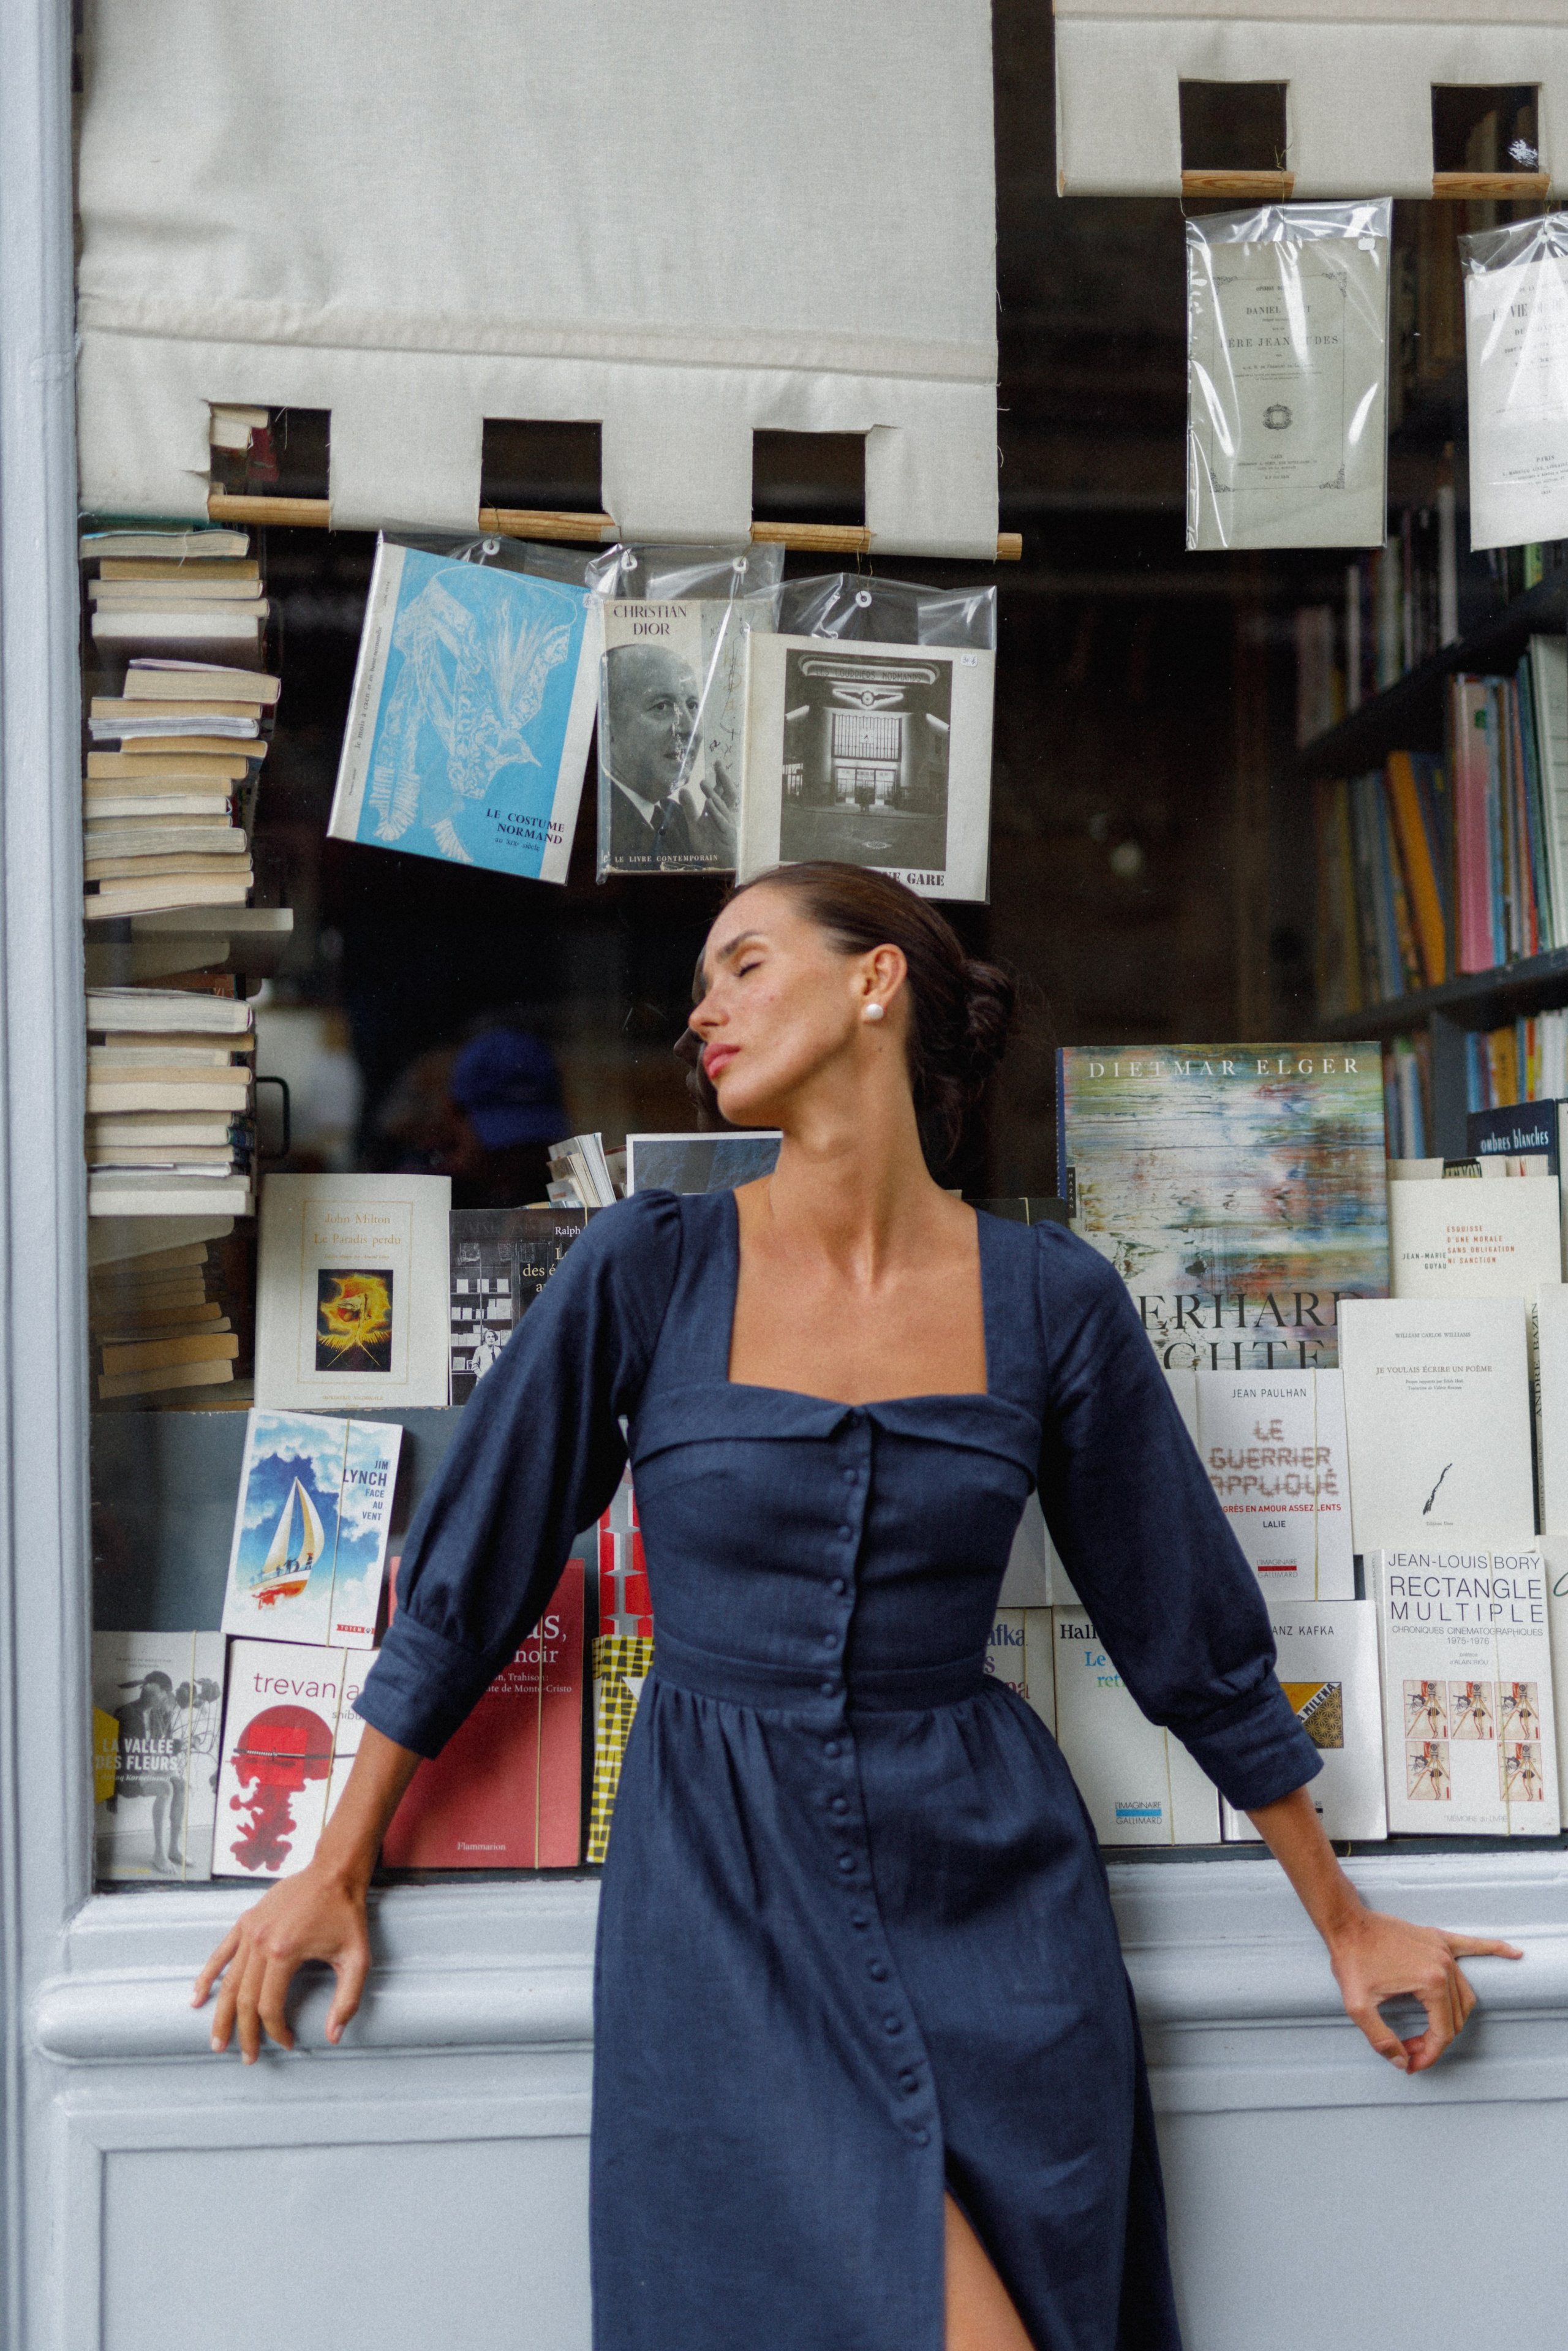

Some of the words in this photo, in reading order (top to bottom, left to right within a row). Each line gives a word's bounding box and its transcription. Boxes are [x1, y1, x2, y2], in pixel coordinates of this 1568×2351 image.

[1246, 306, 1281, 315] DANIEL
[1257, 338, 1291, 347] JEAN
[1306, 336, 1339, 345] UDES
[614, 605, 687, 618] CHRISTIAN
[633, 622, 670, 636] DIOR
[882, 671, 922, 682] NORMANDS
[486, 808, 501, 819] LE
[507, 812, 565, 832] COSTUME
[497, 823, 563, 844] NORMAND
[522, 842, 541, 851] siècle
[656, 854, 718, 862] CONTEMPORAIN
[907, 872, 944, 886] GARE
[1088, 1060, 1237, 1079] DIETMAR
[1256, 1058, 1359, 1076] ELGER
[325, 1213, 350, 1224] John
[355, 1213, 391, 1225] Milton
[555, 1226, 581, 1237] Ralph
[313, 1233, 328, 1245] Le
[332, 1233, 368, 1245] Paradis
[372, 1234, 401, 1248] perdu
[522, 1263, 545, 1277] des
[1139, 1290, 1363, 1330] ERHAR
[1376, 1367, 1385, 1375] JE
[1232, 1389, 1256, 1398] JEAN
[1261, 1388, 1307, 1398] PAULHAN
[1253, 1419, 1284, 1442] LE
[374, 1460, 389, 1470] JIM
[1208, 1446, 1332, 1471] GUERRIER
[343, 1468, 387, 1487] LYNCH
[1209, 1468, 1340, 1498] APPLIQUÉ
[365, 1489, 385, 1498] FACE
[372, 1501, 383, 1509] AU
[1221, 1503, 1244, 1513] GRÈS
[362, 1511, 382, 1521] VENT
[1389, 1553, 1488, 1569] JEAN-LOUIS
[1494, 1557, 1540, 1569] BORY
[1390, 1576, 1542, 1599] RECTANGLE
[1391, 1601, 1544, 1623] MULTIPLE
[987, 1624, 1028, 1647] afka
[1060, 1624, 1100, 1640] Hall
[1272, 1626, 1293, 1636] ANZ
[1299, 1626, 1335, 1636] KAFKA
[1392, 1625, 1444, 1634] CHRONIQUES
[1447, 1626, 1544, 1637] CINEMATOGRAPHIQUES
[514, 1645, 559, 1663] noir
[1084, 1651, 1106, 1667] Le
[254, 1673, 360, 1700] trevana
[501, 1683, 511, 1692] de
[1096, 1673, 1126, 1688] ret
[1302, 1683, 1336, 1716] MILENA
[103, 1738, 119, 1753] LA
[96, 1755, 123, 1770] DES
[126, 1755, 178, 1771] FLEURS
[1115, 1801, 1162, 1809] L'IMAGINAIRE
[456, 1841, 506, 1851] Flammarion
